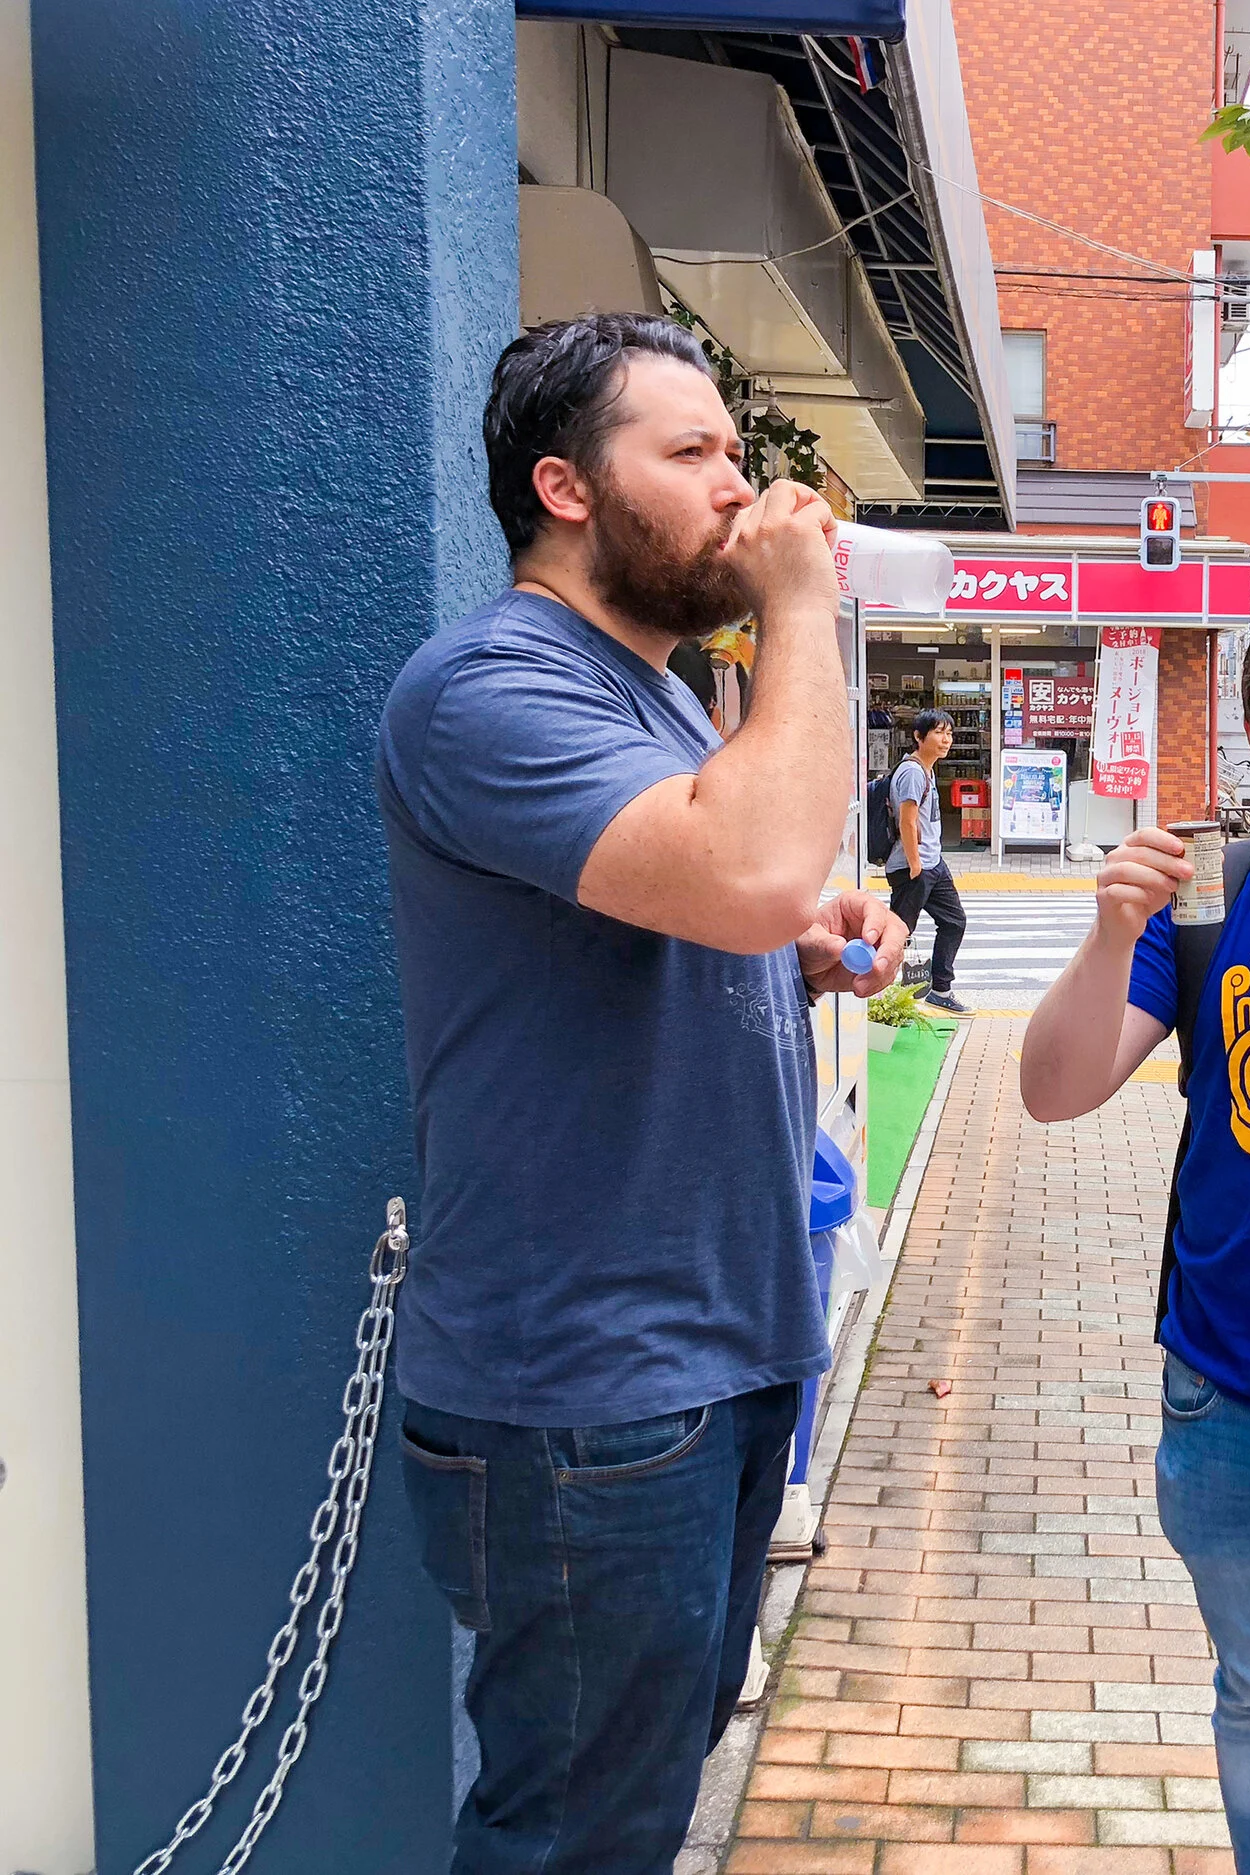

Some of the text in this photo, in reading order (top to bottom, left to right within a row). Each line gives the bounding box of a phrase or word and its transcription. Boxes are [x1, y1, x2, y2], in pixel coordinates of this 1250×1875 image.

[834, 539, 853, 592] evian
[950, 569, 1069, 601] カクヤス
